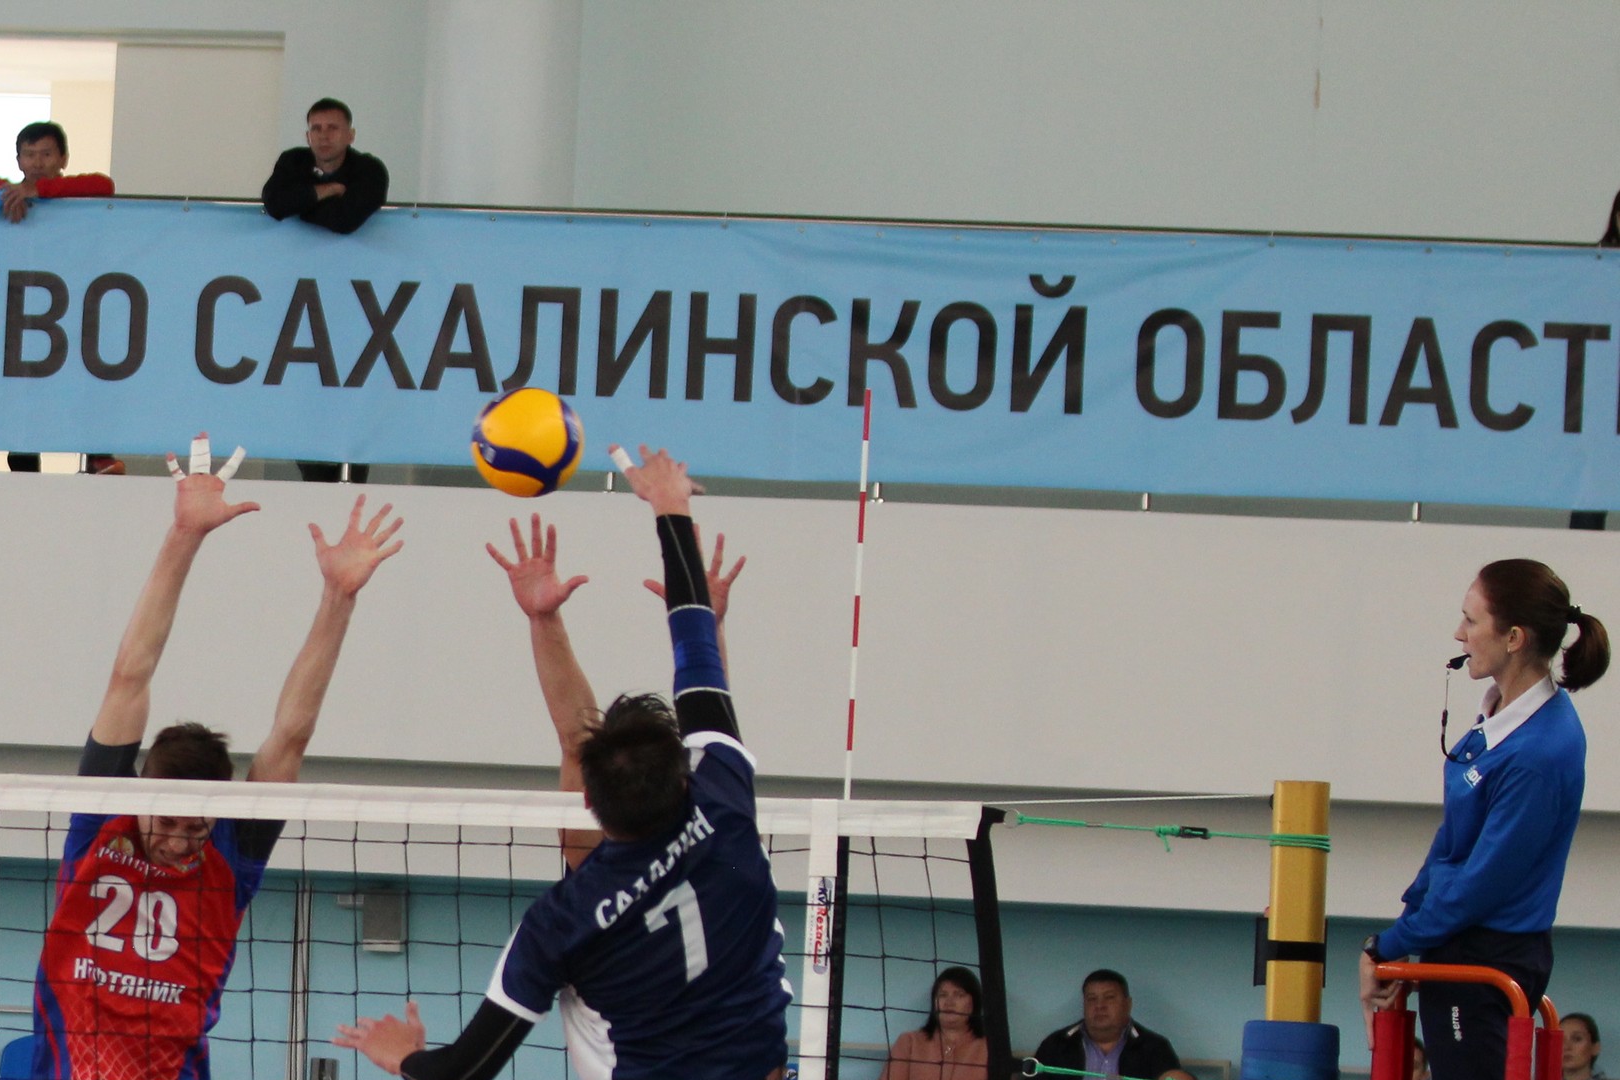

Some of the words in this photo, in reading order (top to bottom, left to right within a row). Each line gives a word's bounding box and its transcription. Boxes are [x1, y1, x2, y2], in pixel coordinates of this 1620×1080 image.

[193, 273, 1087, 415] САХАЛИНСКОЙ
[1134, 305, 1620, 436] ОБЛАСТ
[86, 874, 179, 962] 20
[643, 880, 708, 984] 7
